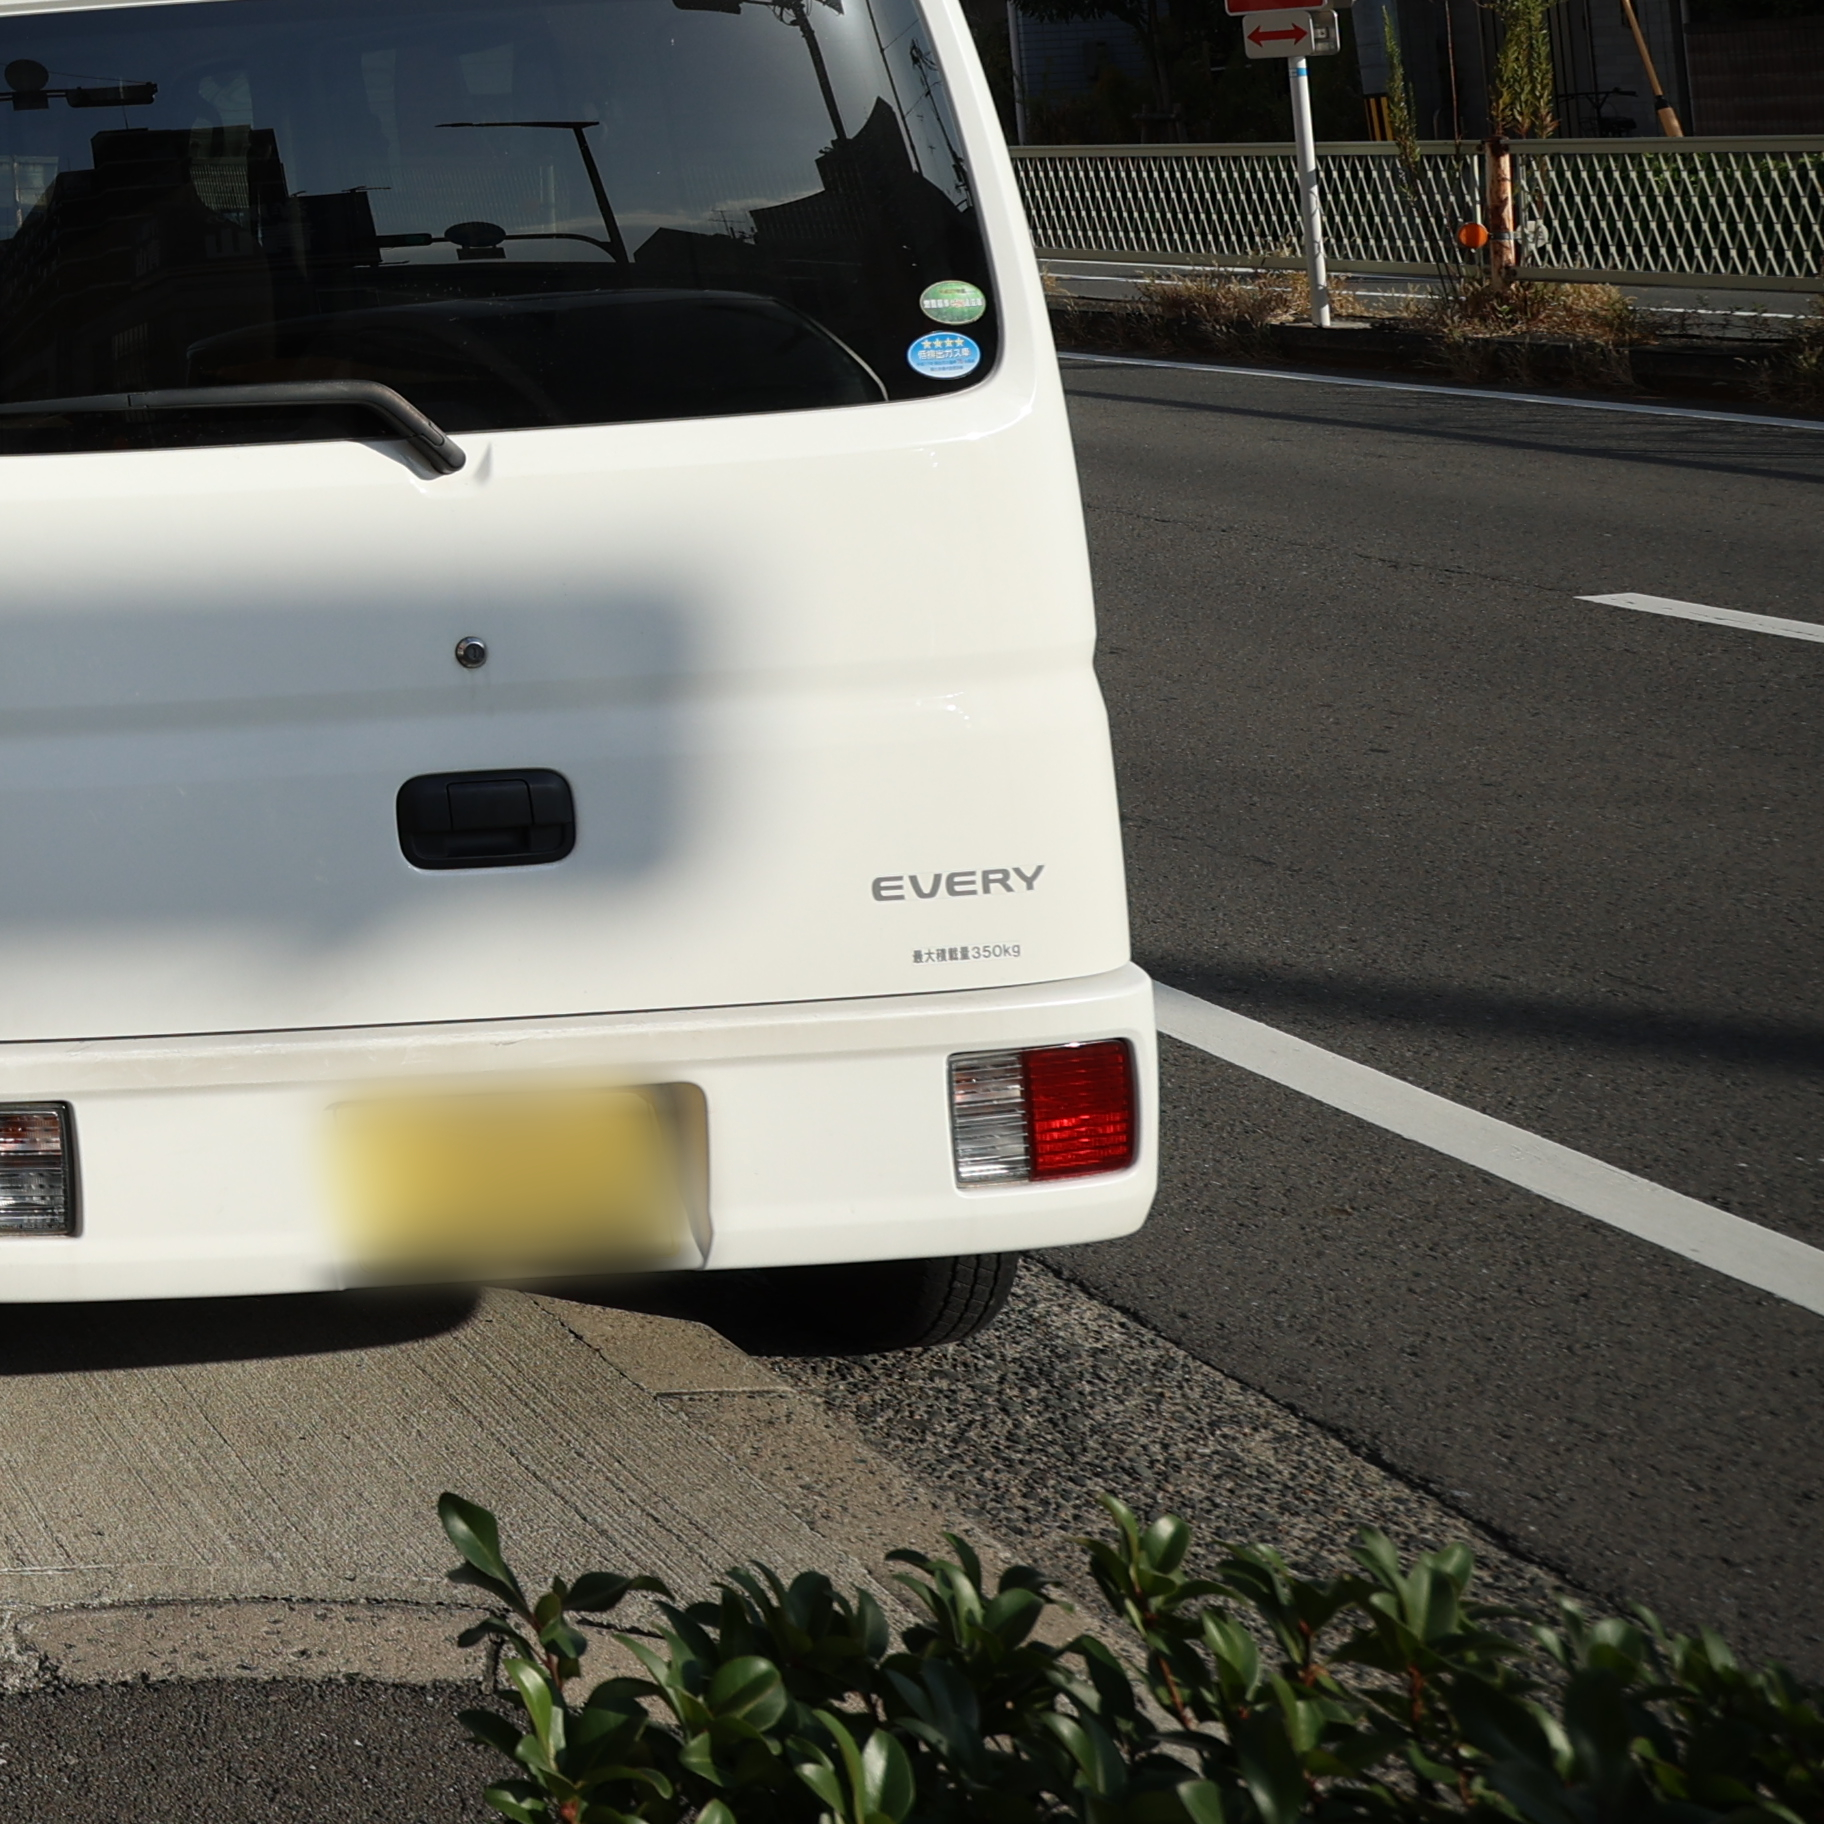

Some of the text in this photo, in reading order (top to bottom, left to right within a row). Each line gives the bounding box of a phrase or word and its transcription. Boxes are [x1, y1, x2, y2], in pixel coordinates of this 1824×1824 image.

[871, 864, 1045, 902] EVERY
[912, 943, 1021, 964] 最大積載量350kg
